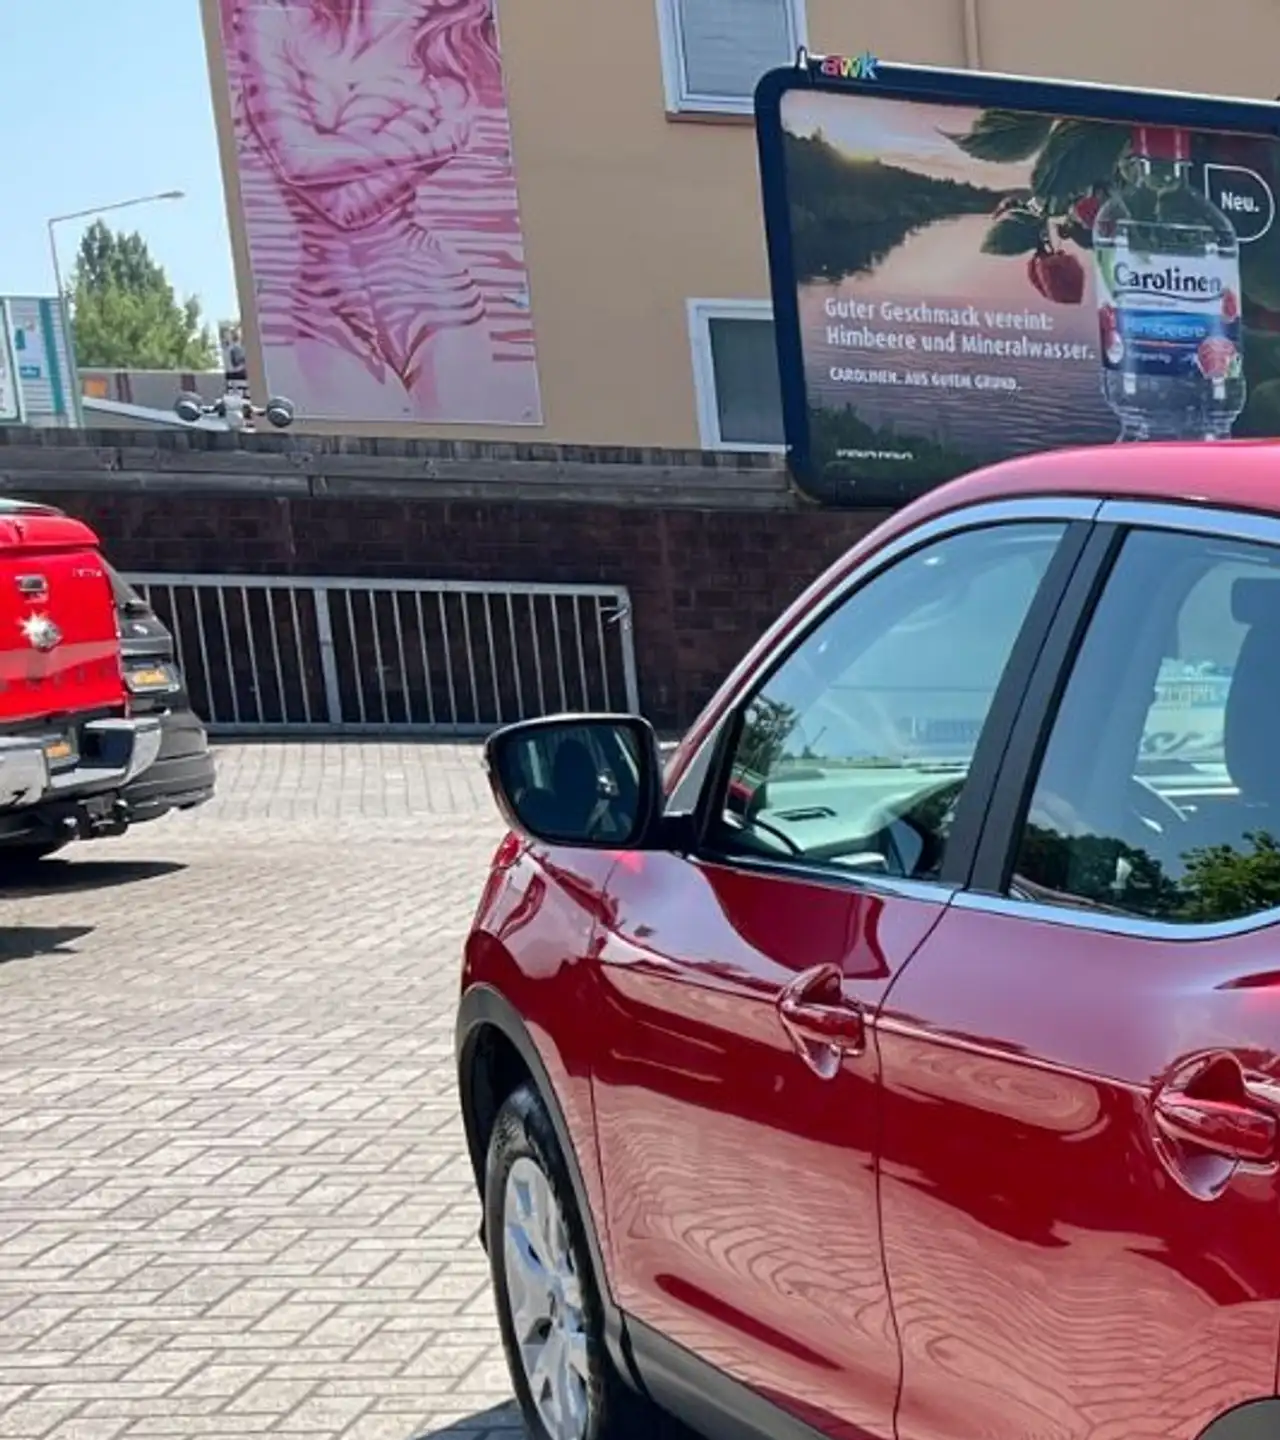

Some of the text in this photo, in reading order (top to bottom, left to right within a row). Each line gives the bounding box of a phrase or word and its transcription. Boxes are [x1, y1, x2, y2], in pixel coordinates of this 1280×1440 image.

[820, 54, 879, 79] awk
[1221, 192, 1260, 213] Neu.
[1114, 262, 1222, 292] Carolinen
[825, 298, 1054, 331] Guter Geschmack vereint:
[826, 324, 1097, 360] Himbeere und Mineralwasser.
[905, 372, 928, 387] AUS
